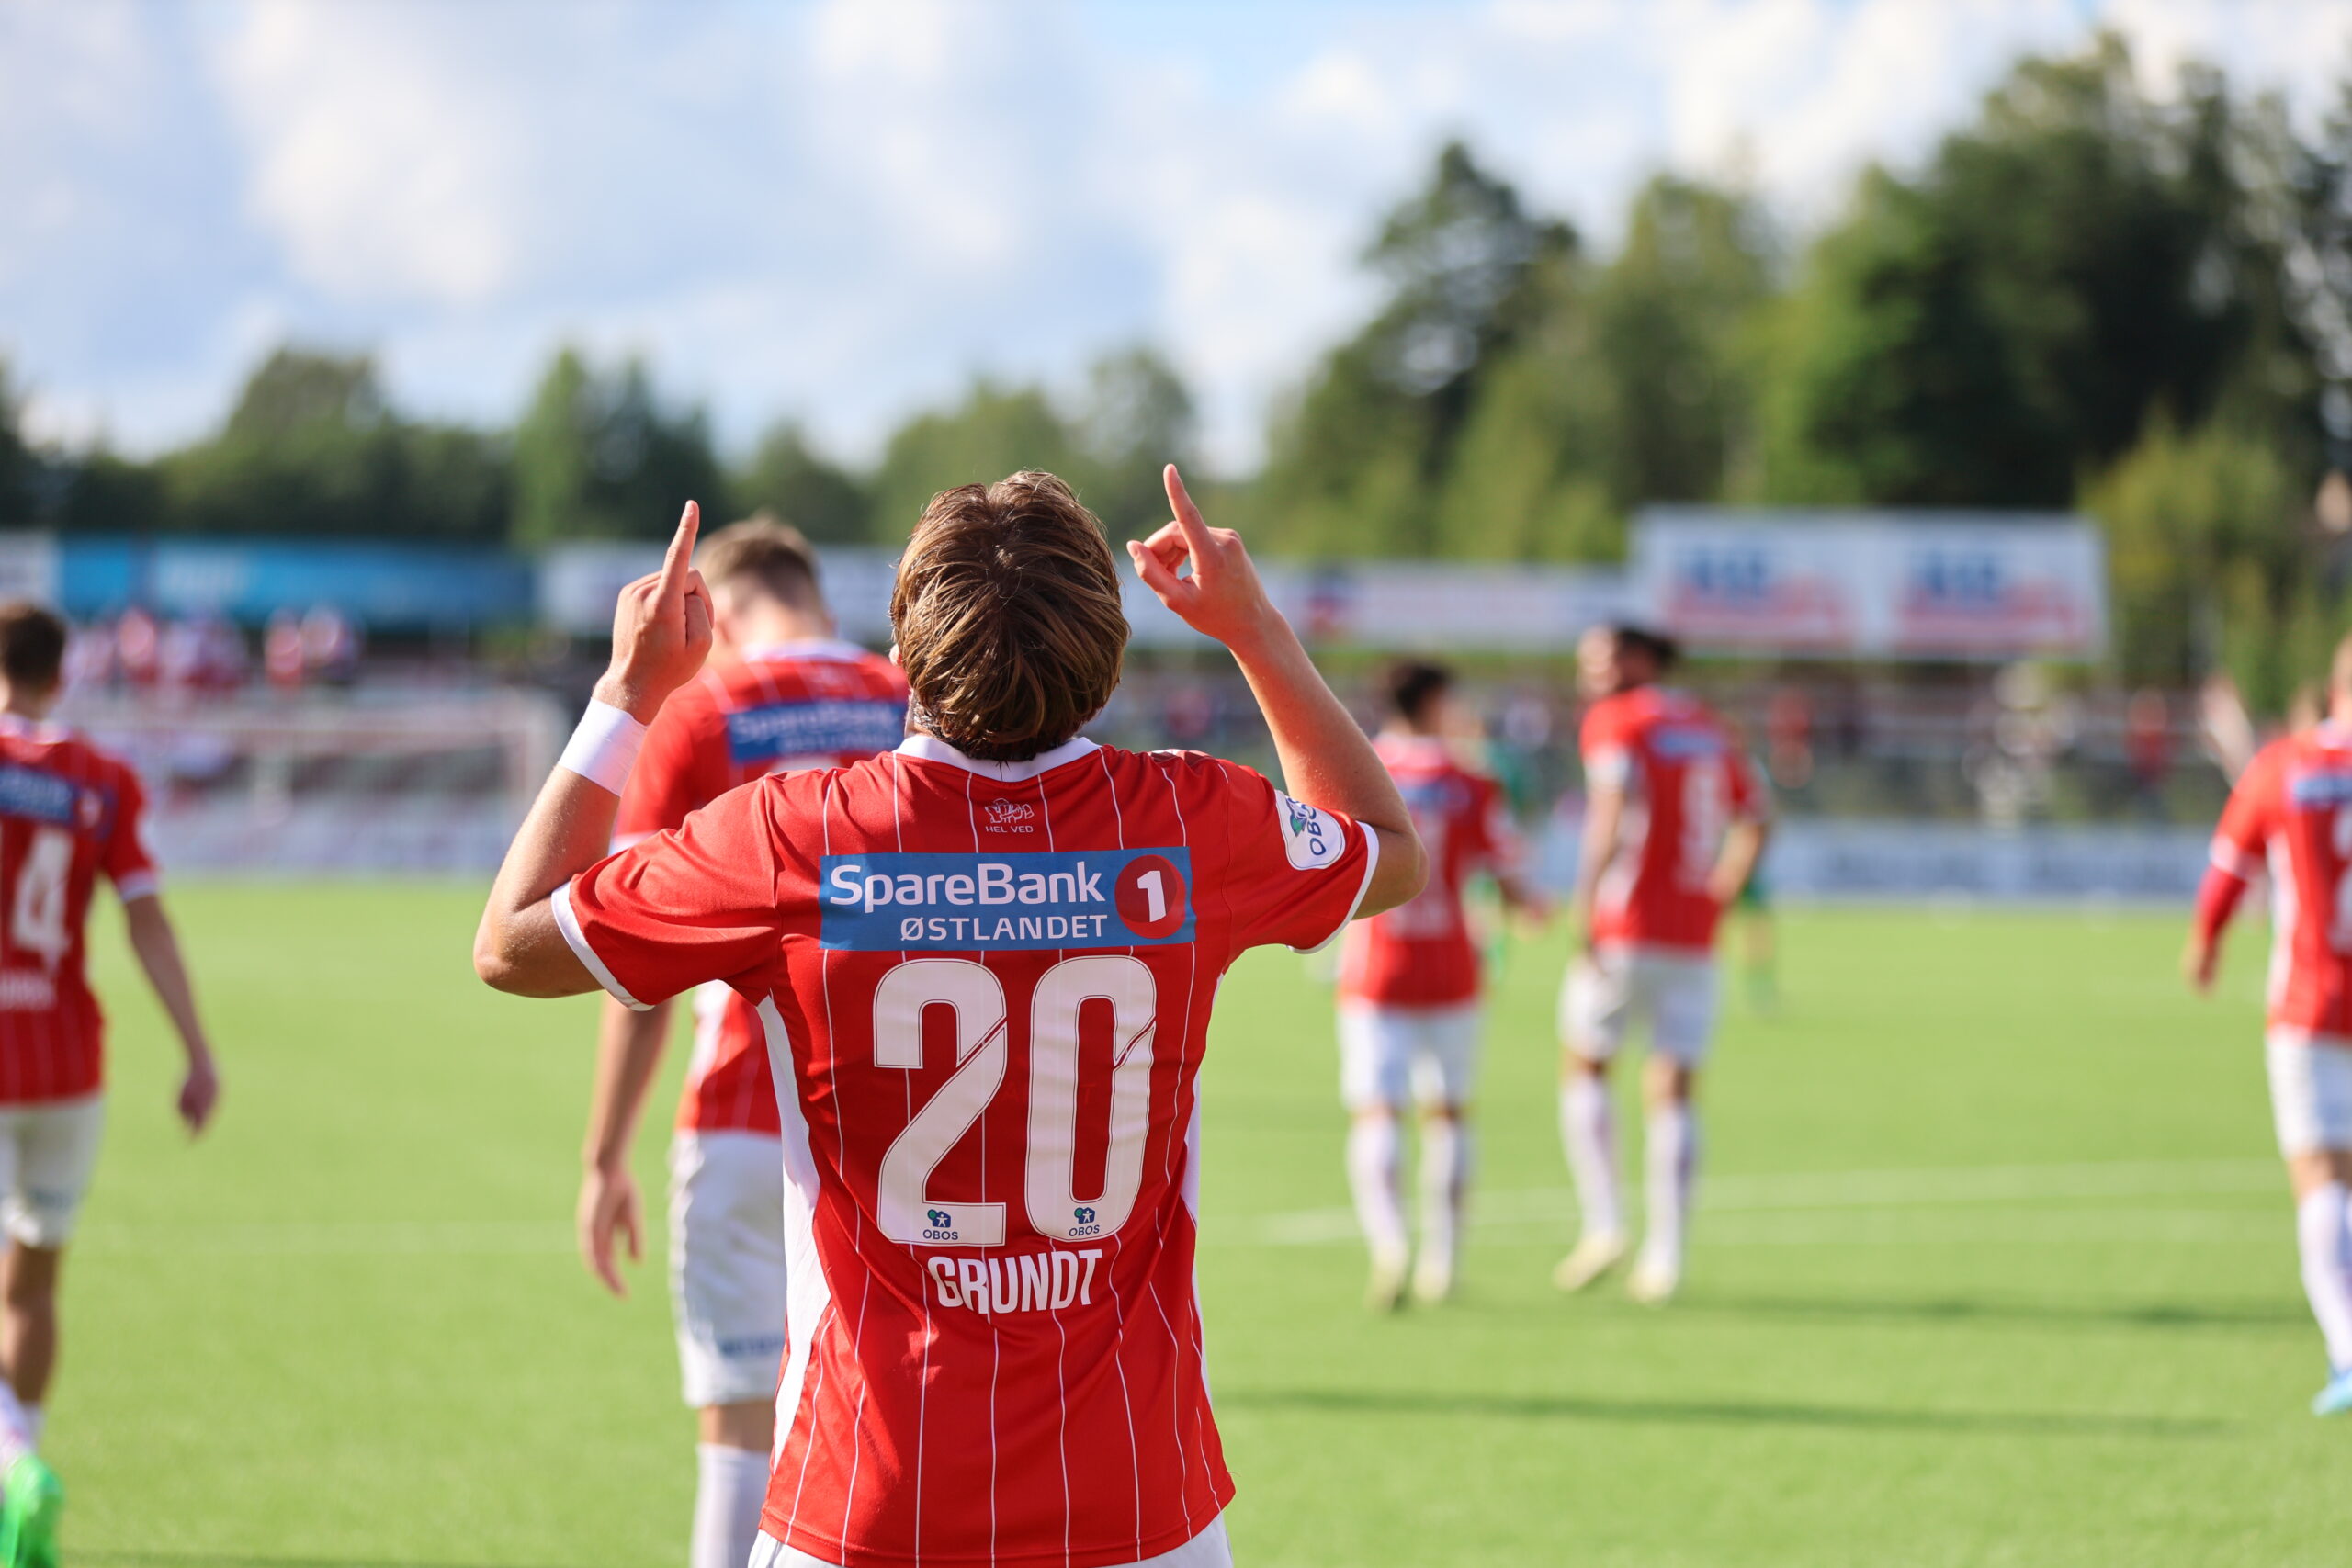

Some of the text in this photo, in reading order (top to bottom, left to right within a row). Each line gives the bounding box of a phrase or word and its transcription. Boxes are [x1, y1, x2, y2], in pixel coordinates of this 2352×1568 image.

[986, 825, 1034, 833] HEL VED
[830, 861, 1168, 923] SpareBank 1
[899, 915, 1108, 942] ØSTLANDET
[873, 955, 1158, 1247] 20
[922, 1229, 959, 1241] OBOS
[1069, 1224, 1101, 1237] OBOS
[927, 1249, 1103, 1314] GRUNDT
